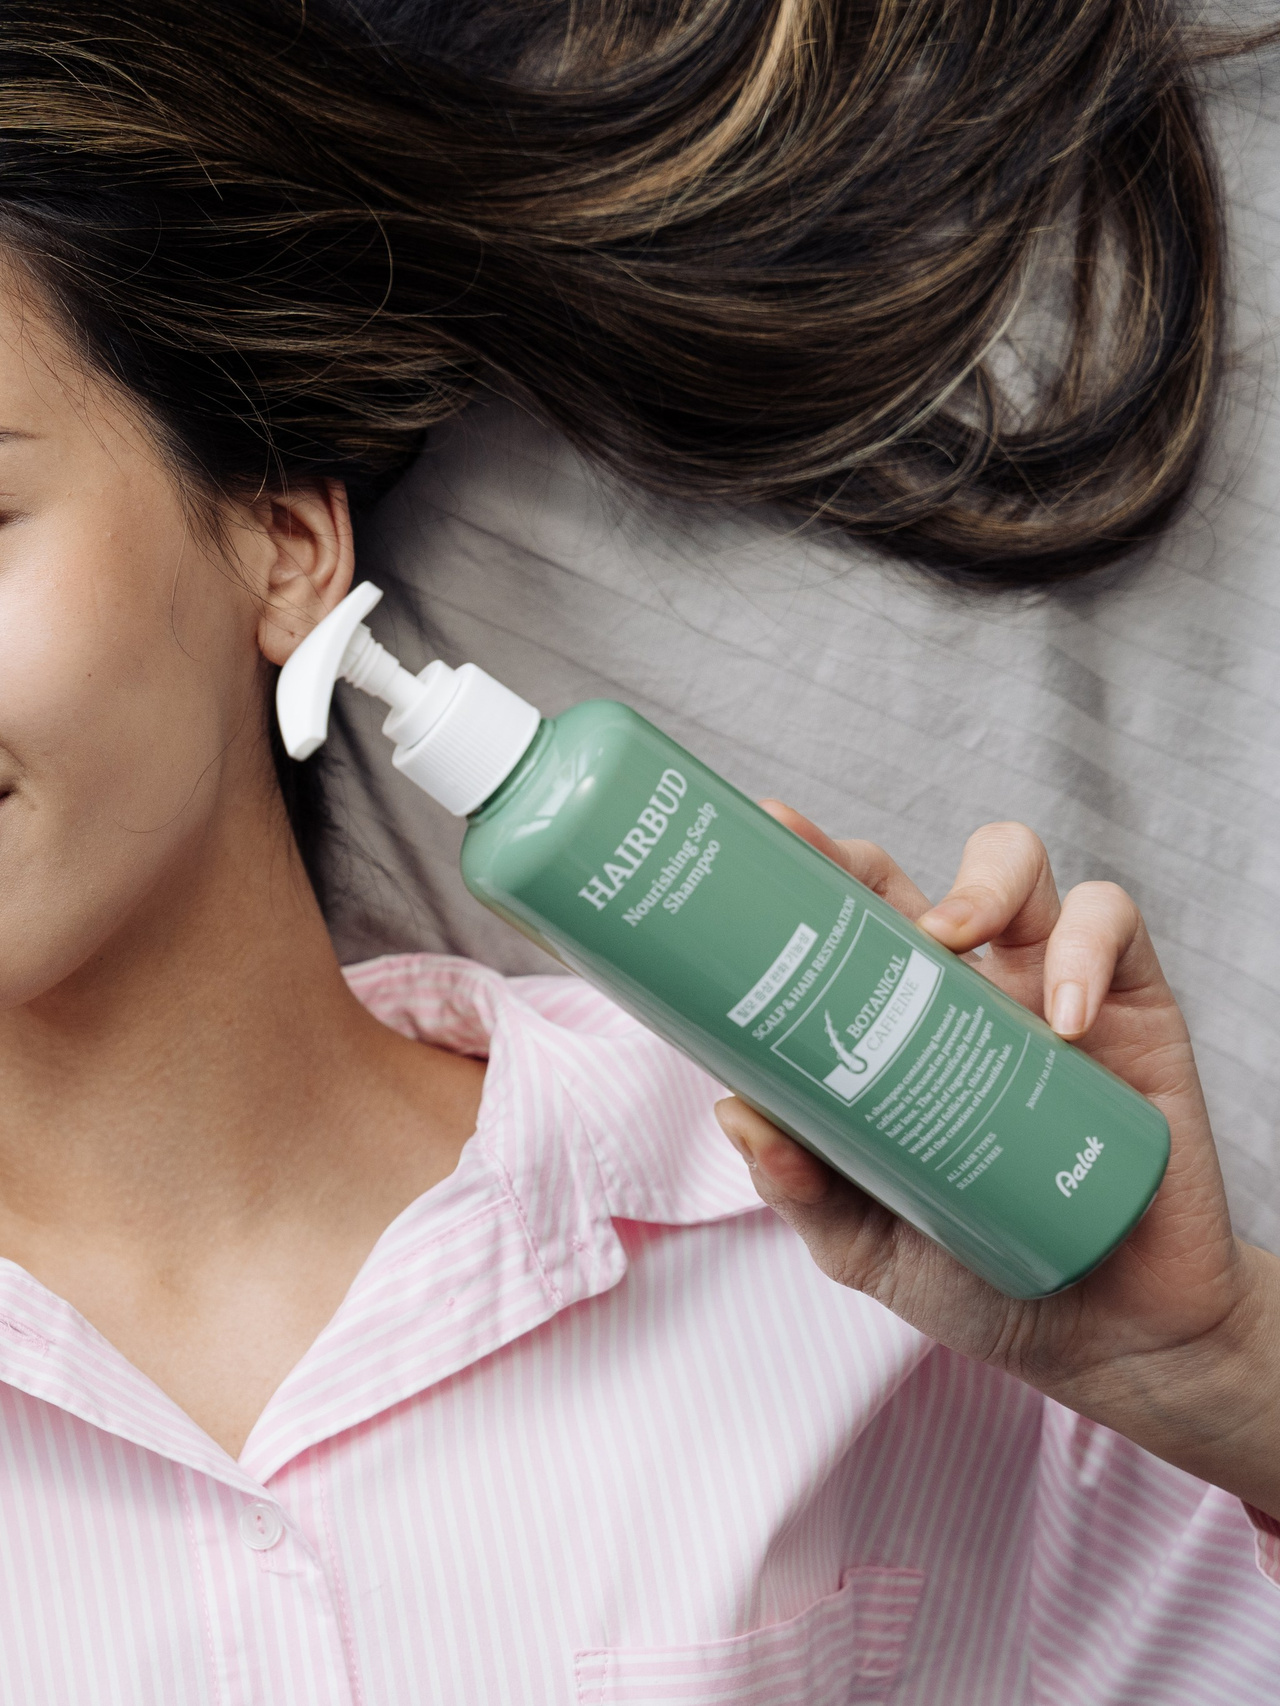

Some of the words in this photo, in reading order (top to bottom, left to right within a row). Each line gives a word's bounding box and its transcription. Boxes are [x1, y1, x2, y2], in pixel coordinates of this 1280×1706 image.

[579, 768, 687, 909] HAIRBUD
[622, 839, 699, 925] Nourishing
[686, 802, 718, 843] Scalp
[662, 839, 720, 913] Shampoo
[752, 1005, 788, 1039] SCALP
[788, 968, 819, 1001] HAIR
[811, 894, 856, 972] RESTORATION
[846, 954, 906, 1039] BOTANICAL
[863, 975, 920, 1053] CAFFEINE
[864, 1114, 874, 1122] A
[871, 1082, 905, 1116] shampoo
[902, 1040, 939, 1085] containing
[930, 1003, 957, 1042] botanical
[876, 1101, 906, 1130] caffeine
[901, 1094, 913, 1104] is
[908, 1063, 937, 1096] focused
[933, 1053, 946, 1066] on
[941, 1010, 970, 1056] preventing
[884, 1122, 904, 1138] hair
[897, 1104, 921, 1126] loss.
[915, 1091, 933, 1108] The
[930, 1041, 969, 1093] scientifically
[897, 1121, 925, 1146] unique
[919, 1099, 944, 1124] blend
[940, 1090, 951, 1103] of
[947, 1047, 981, 1093] ingredients
[975, 1020, 993, 1048] targets
[976, 1059, 1004, 1098] beautiful
[997, 1044, 1012, 1062] hair.
[908, 1118, 946, 1153] weakened
[941, 1089, 973, 1121] follicles,
[967, 1048, 997, 1088] thickness,
[945, 1105, 975, 1138] creation
[971, 1094, 982, 1107] of
[920, 1146, 937, 1162] and
[932, 1136, 948, 1150] the
[946, 1169, 962, 1182] ALL
[957, 1152, 978, 1171] HAIR
[973, 1131, 997, 1155] TYPES
[956, 1161, 988, 1189] SULFATE
[983, 1144, 1003, 1165] FREE
[1055, 1136, 1104, 1197] Aalok
